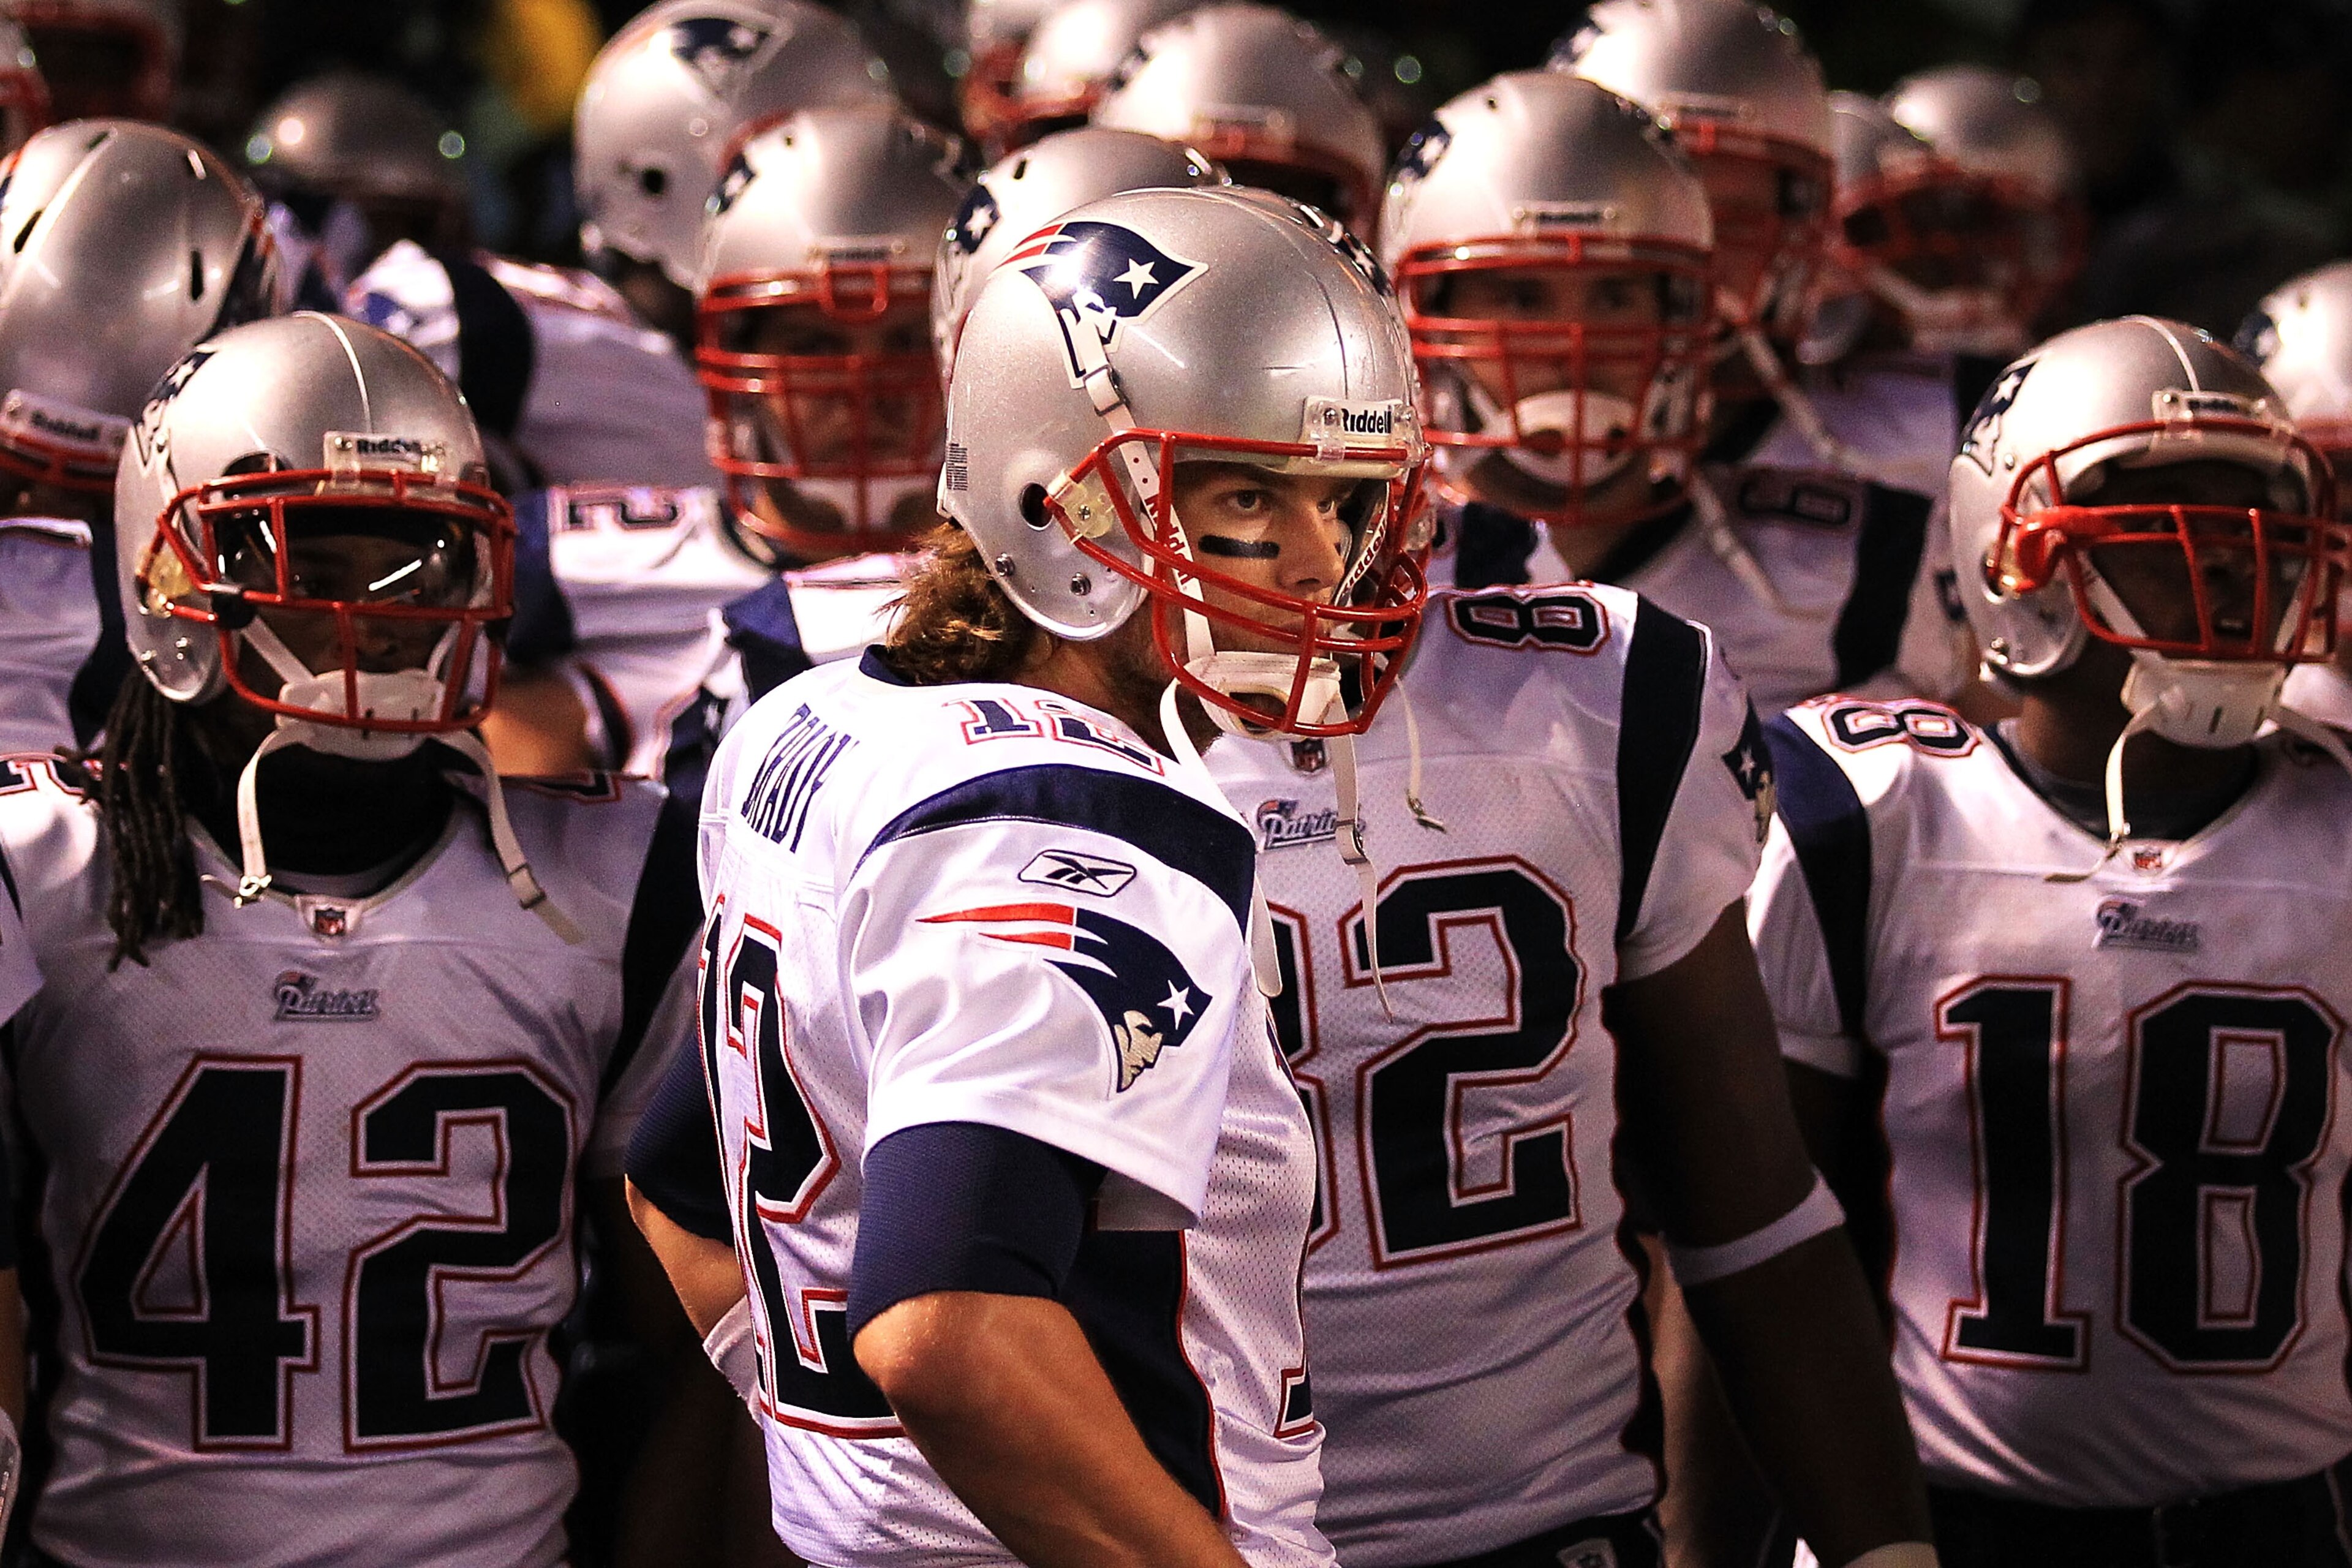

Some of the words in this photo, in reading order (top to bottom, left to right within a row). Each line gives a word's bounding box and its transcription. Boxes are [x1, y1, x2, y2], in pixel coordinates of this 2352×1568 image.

[1447, 583, 1610, 655] 8
[941, 697, 1165, 777] 12
[1820, 697, 1980, 758] 8
[1934, 974, 2347, 1375] 18
[72, 1053, 577, 1454] 42
